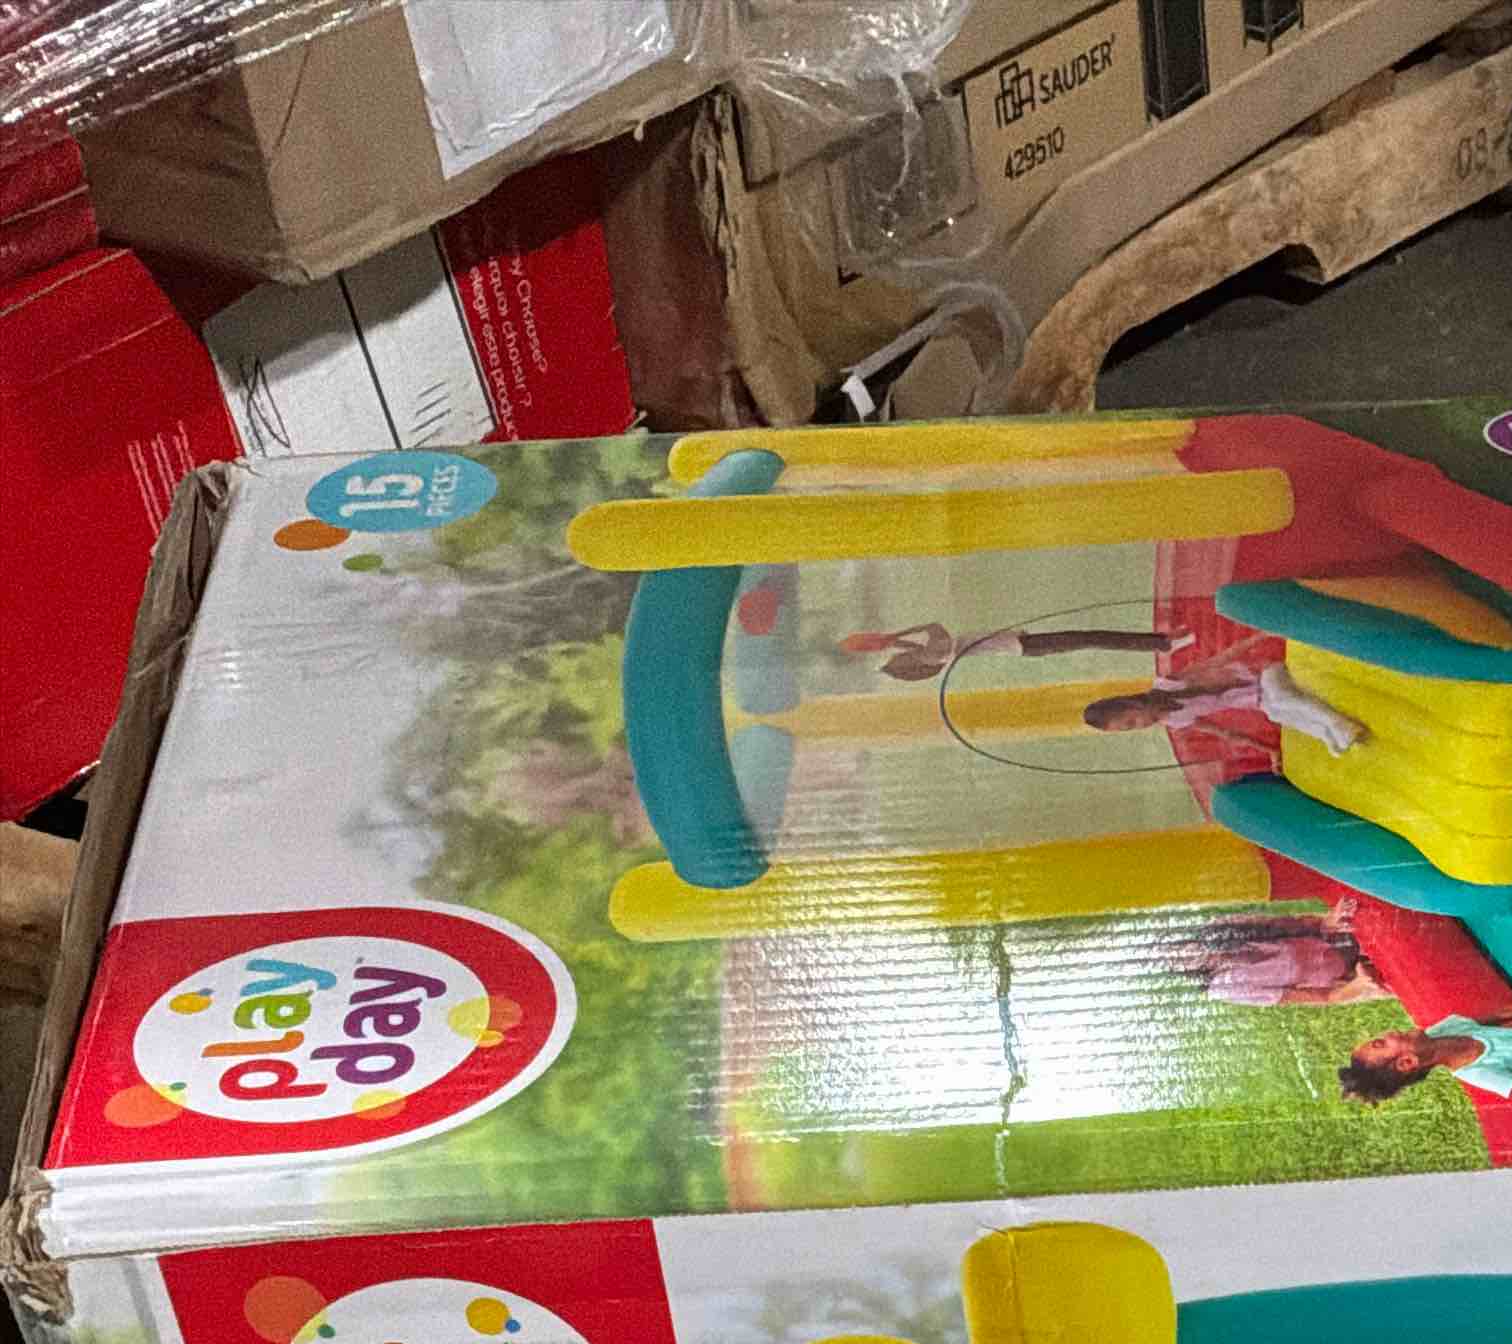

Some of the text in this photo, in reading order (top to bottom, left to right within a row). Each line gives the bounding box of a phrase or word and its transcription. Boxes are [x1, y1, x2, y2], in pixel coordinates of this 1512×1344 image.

[1040, 41, 1113, 104] SAUDER
[1004, 126, 1064, 180] 429510
[338, 474, 424, 517] 15
[202, 959, 337, 1100] play
[310, 966, 447, 1084] day
